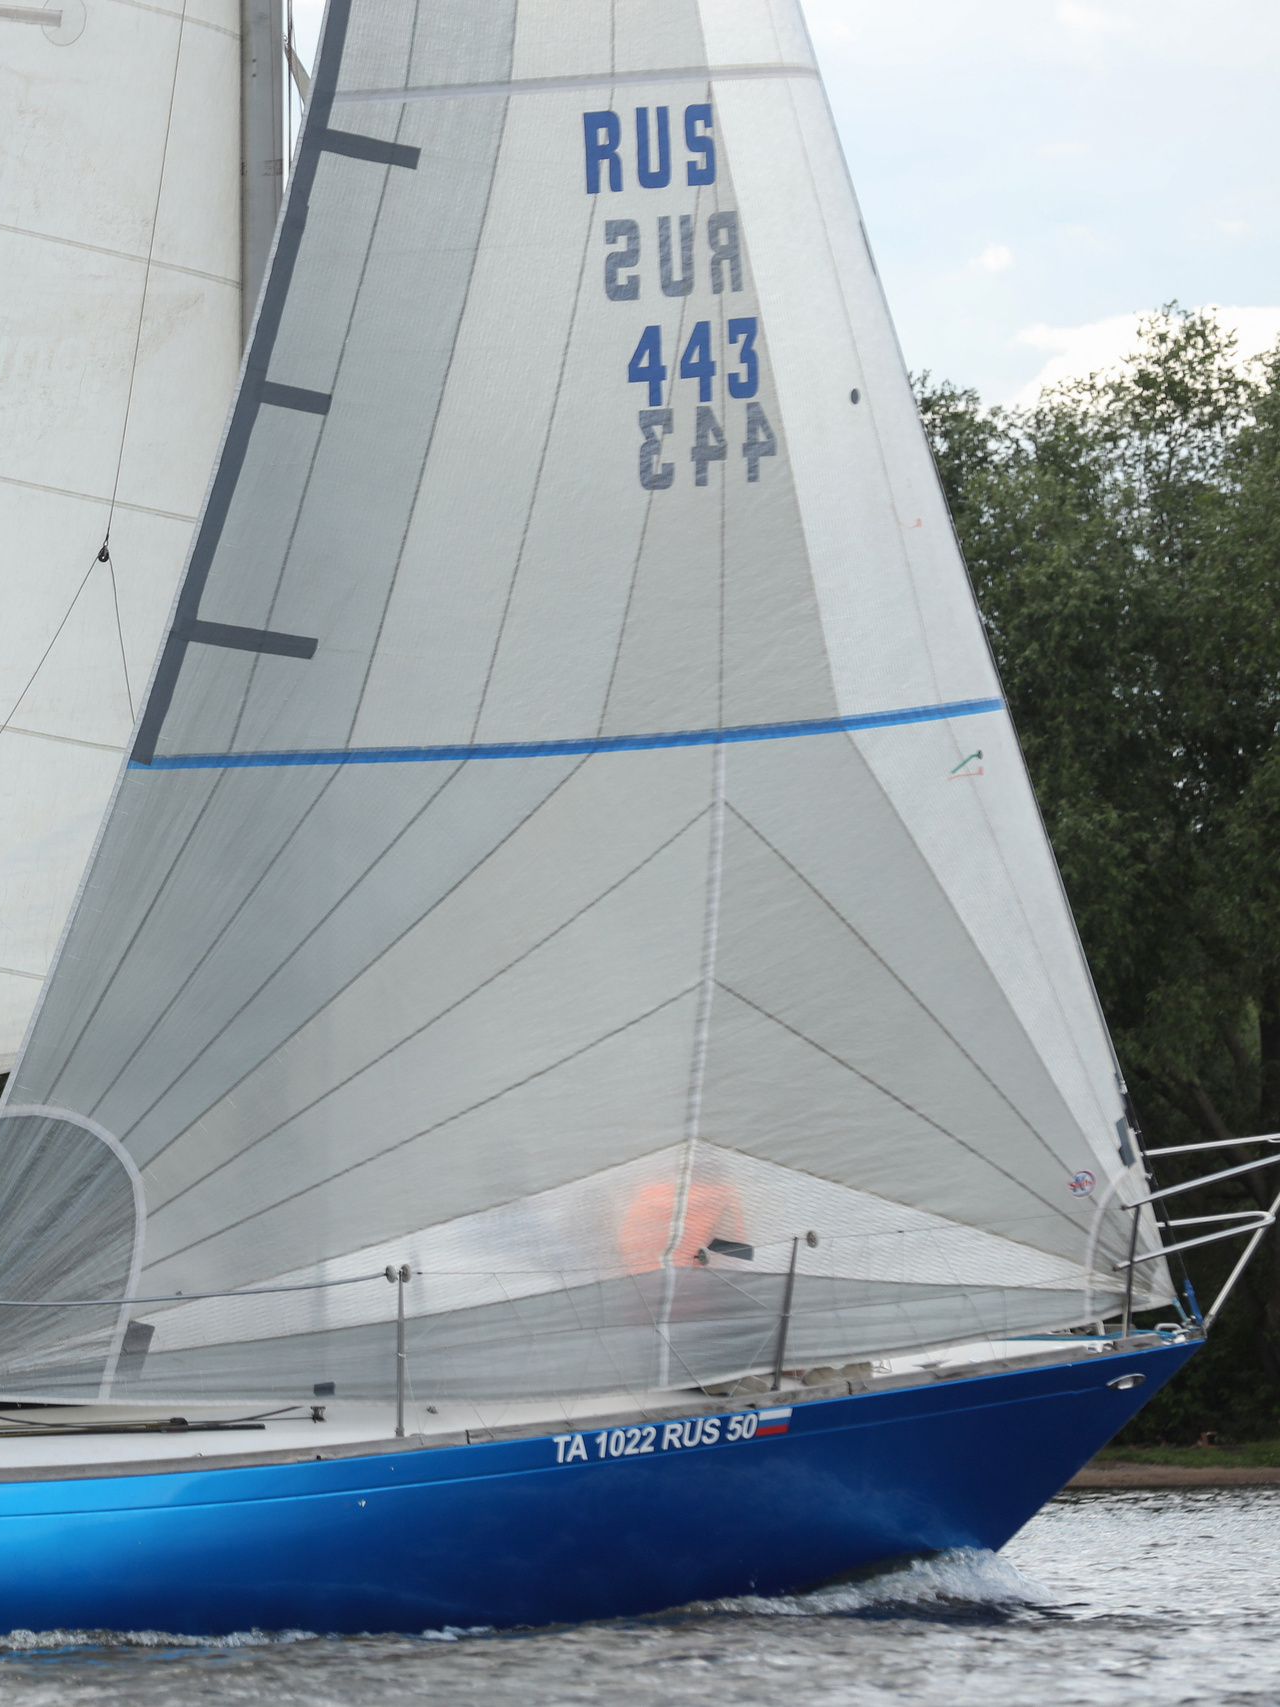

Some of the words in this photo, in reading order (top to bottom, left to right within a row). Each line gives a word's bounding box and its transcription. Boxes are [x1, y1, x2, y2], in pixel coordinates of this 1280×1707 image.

[583, 103, 717, 194] RUS
[628, 316, 759, 407] 443
[552, 1434, 588, 1463] TA
[595, 1426, 657, 1458] 1022
[661, 1418, 721, 1450] RUS
[726, 1413, 758, 1441] 50
